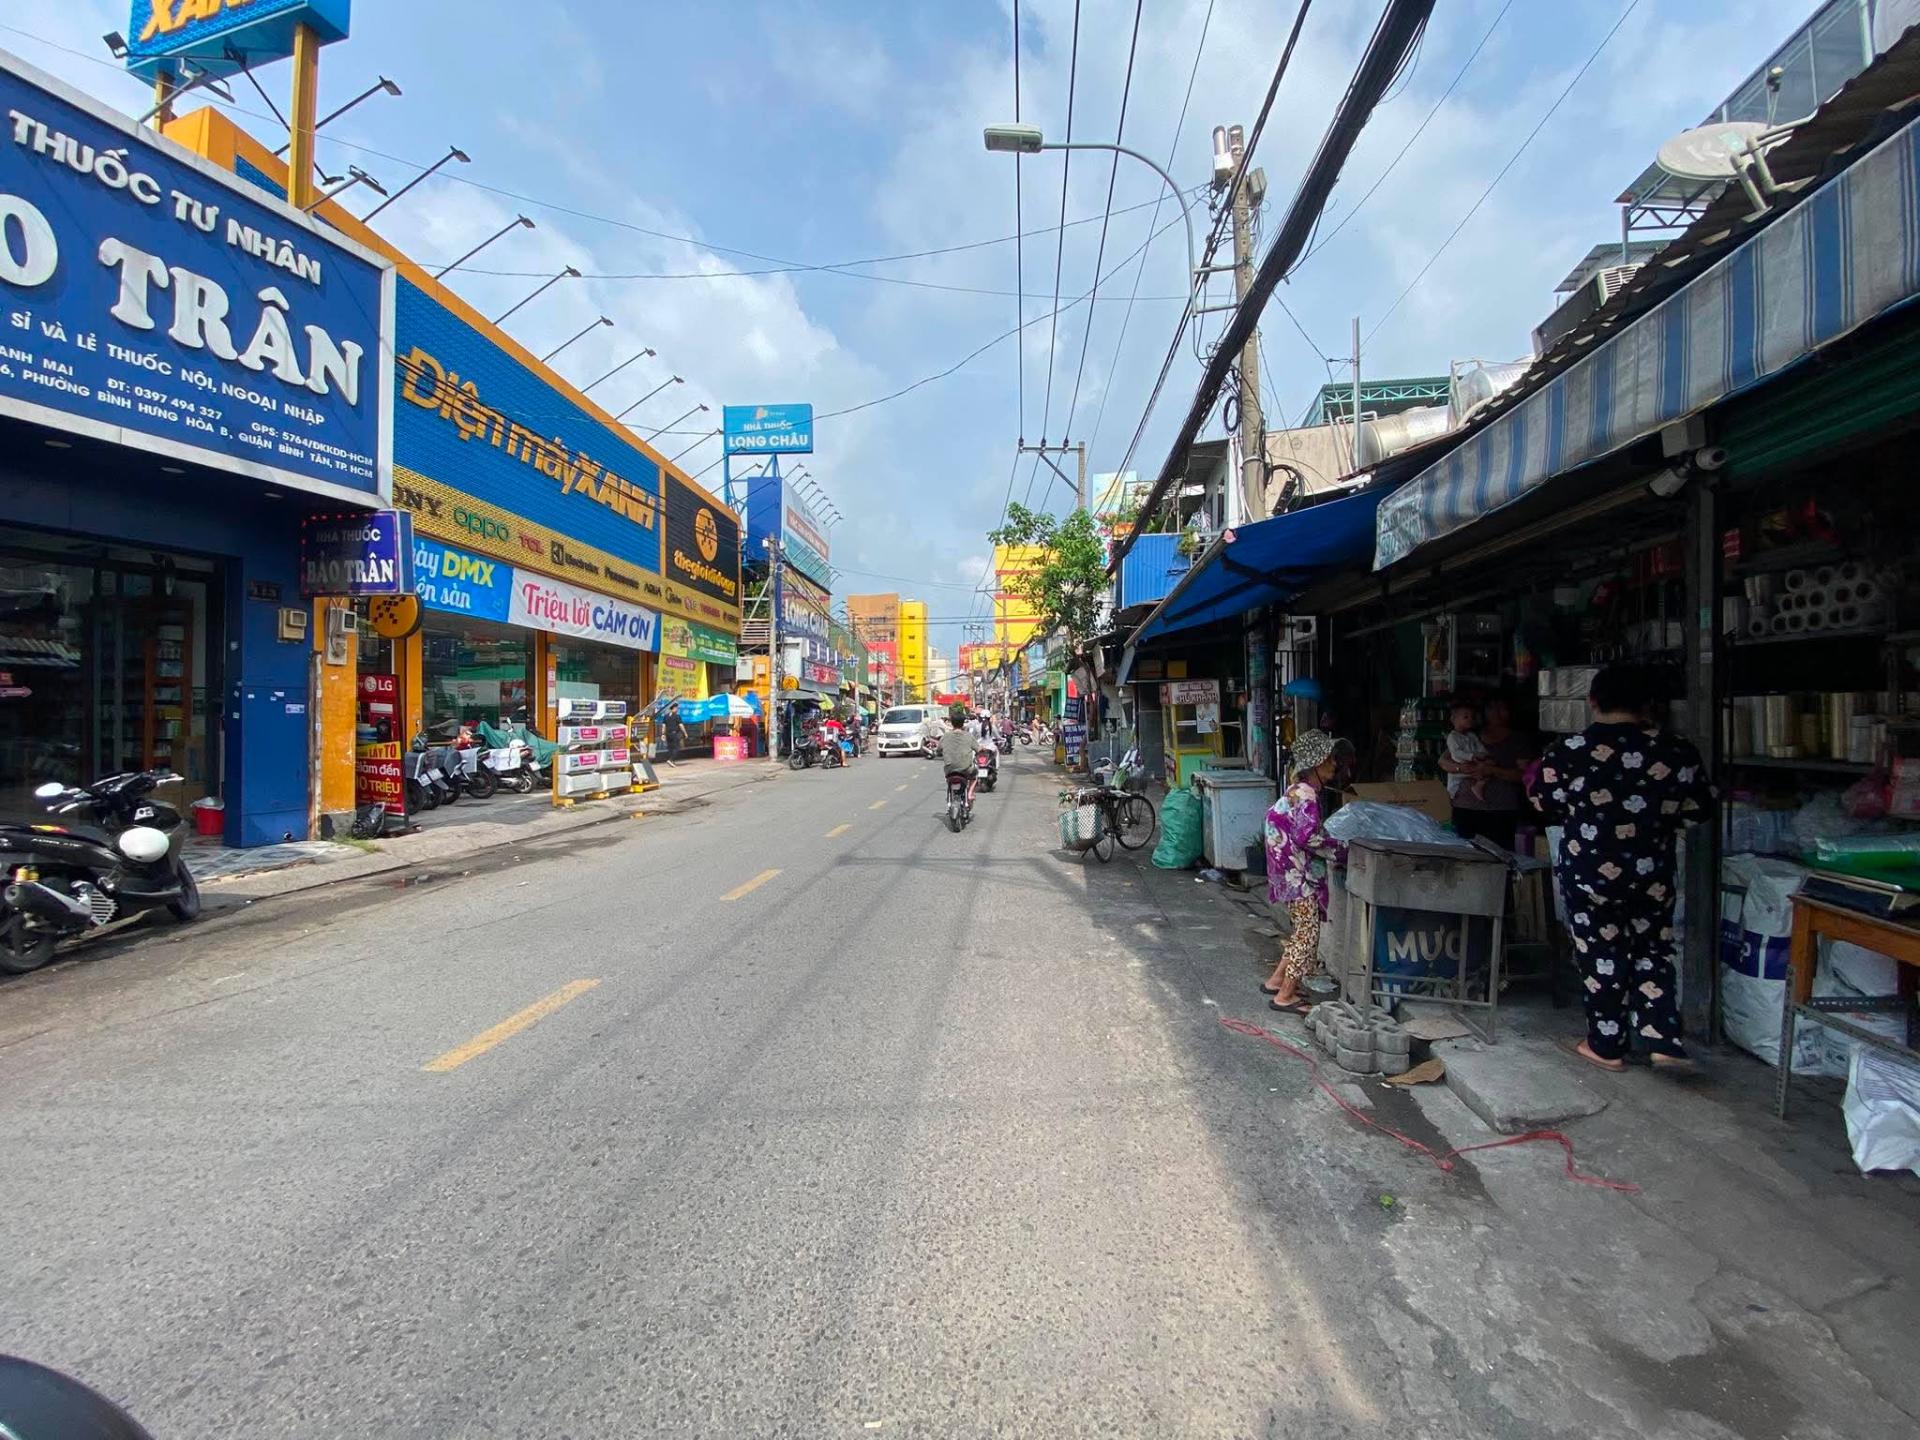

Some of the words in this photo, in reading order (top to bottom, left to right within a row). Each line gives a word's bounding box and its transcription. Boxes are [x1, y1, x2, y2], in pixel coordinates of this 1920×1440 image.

[9, 109, 162, 205] THUỐC
[170, 190, 220, 233] TƯ
[227, 218, 322, 286] NHÂN
[99, 237, 365, 407] TRÂN
[11, 311, 32, 331] SỈ
[41, 321, 68, 343] VÀ
[77, 333, 97, 352] LẺ
[107, 343, 173, 376] THUỐC
[181, 368, 217, 393] NỘI,
[222, 382, 277, 412] NGOẠI
[284, 403, 325, 426] NHẬP
[43, 358, 74, 377] MAI
[107, 378, 131, 393] ĐT:
[134, 386, 168, 403] 0397
[171, 398, 195, 412] 494
[199, 406, 223, 420] 327
[22, 369, 91, 397] PHƯỜNG
[97, 390, 132, 409] BÌNH
[138, 402, 179, 422] HƯNG
[185, 416, 215, 433] HÒA
[220, 426, 234, 439] B,
[238, 432, 273, 449] QUẬN
[278, 442, 305, 459] BÌNH
[350, 466, 374, 479] HCM
[251, 422, 279, 438] GPS:
[397, 345, 503, 448] Điện
[575, 451, 657, 532] XANH
[729, 435, 767, 448] LONG
[769, 431, 808, 446] CHÂU
[341, 523, 382, 542] THUỐC
[344, 551, 395, 584] TRÂN
[442, 549, 496, 588] DMX
[522, 582, 569, 629] Triệu
[572, 596, 591, 628] lời
[592, 599, 628, 636] CẢM
[629, 612, 651, 641] ƠN
[378, 680, 393, 691] LG
[368, 777, 400, 797] TRIỆU
[379, 763, 400, 777] đến
